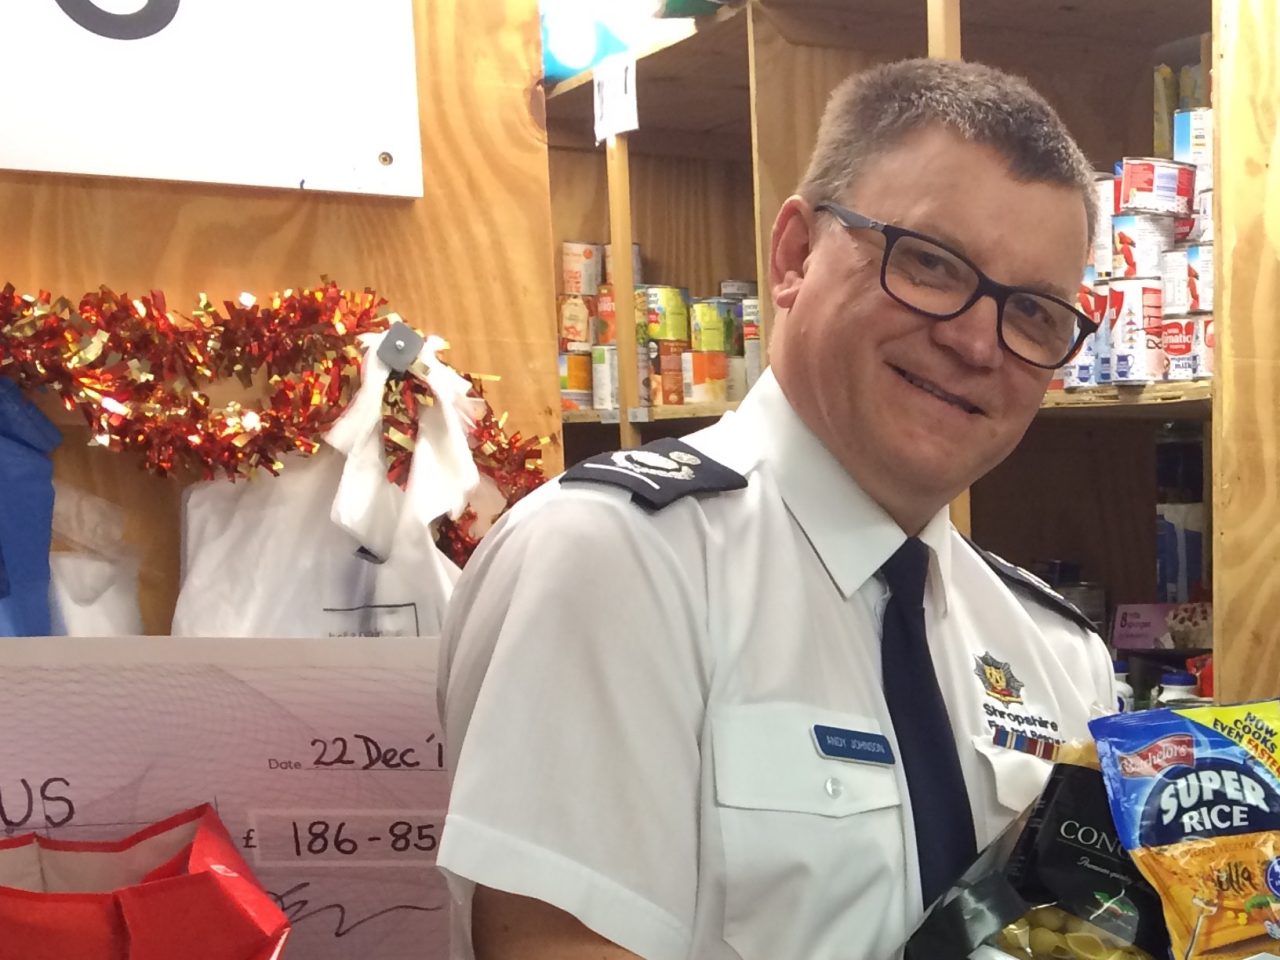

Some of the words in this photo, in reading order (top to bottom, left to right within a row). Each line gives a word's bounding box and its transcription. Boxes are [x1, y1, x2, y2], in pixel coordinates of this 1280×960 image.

[982, 702, 1059, 732] Shropshire
[1212, 717, 1244, 743] EVEN
[1244, 711, 1278, 738] NOW
[825, 735, 847, 748] ANDY
[850, 739, 886, 754] JOHNSON
[1233, 718, 1278, 754] COOKS
[268, 757, 302, 770] Date
[310, 736, 354, 769] 22
[355, 733, 420, 770] Dec
[425, 734, 445, 769] '1
[1159, 770, 1270, 826] SUPER
[1182, 805, 1249, 834] RICE
[242, 829, 257, 849] £
